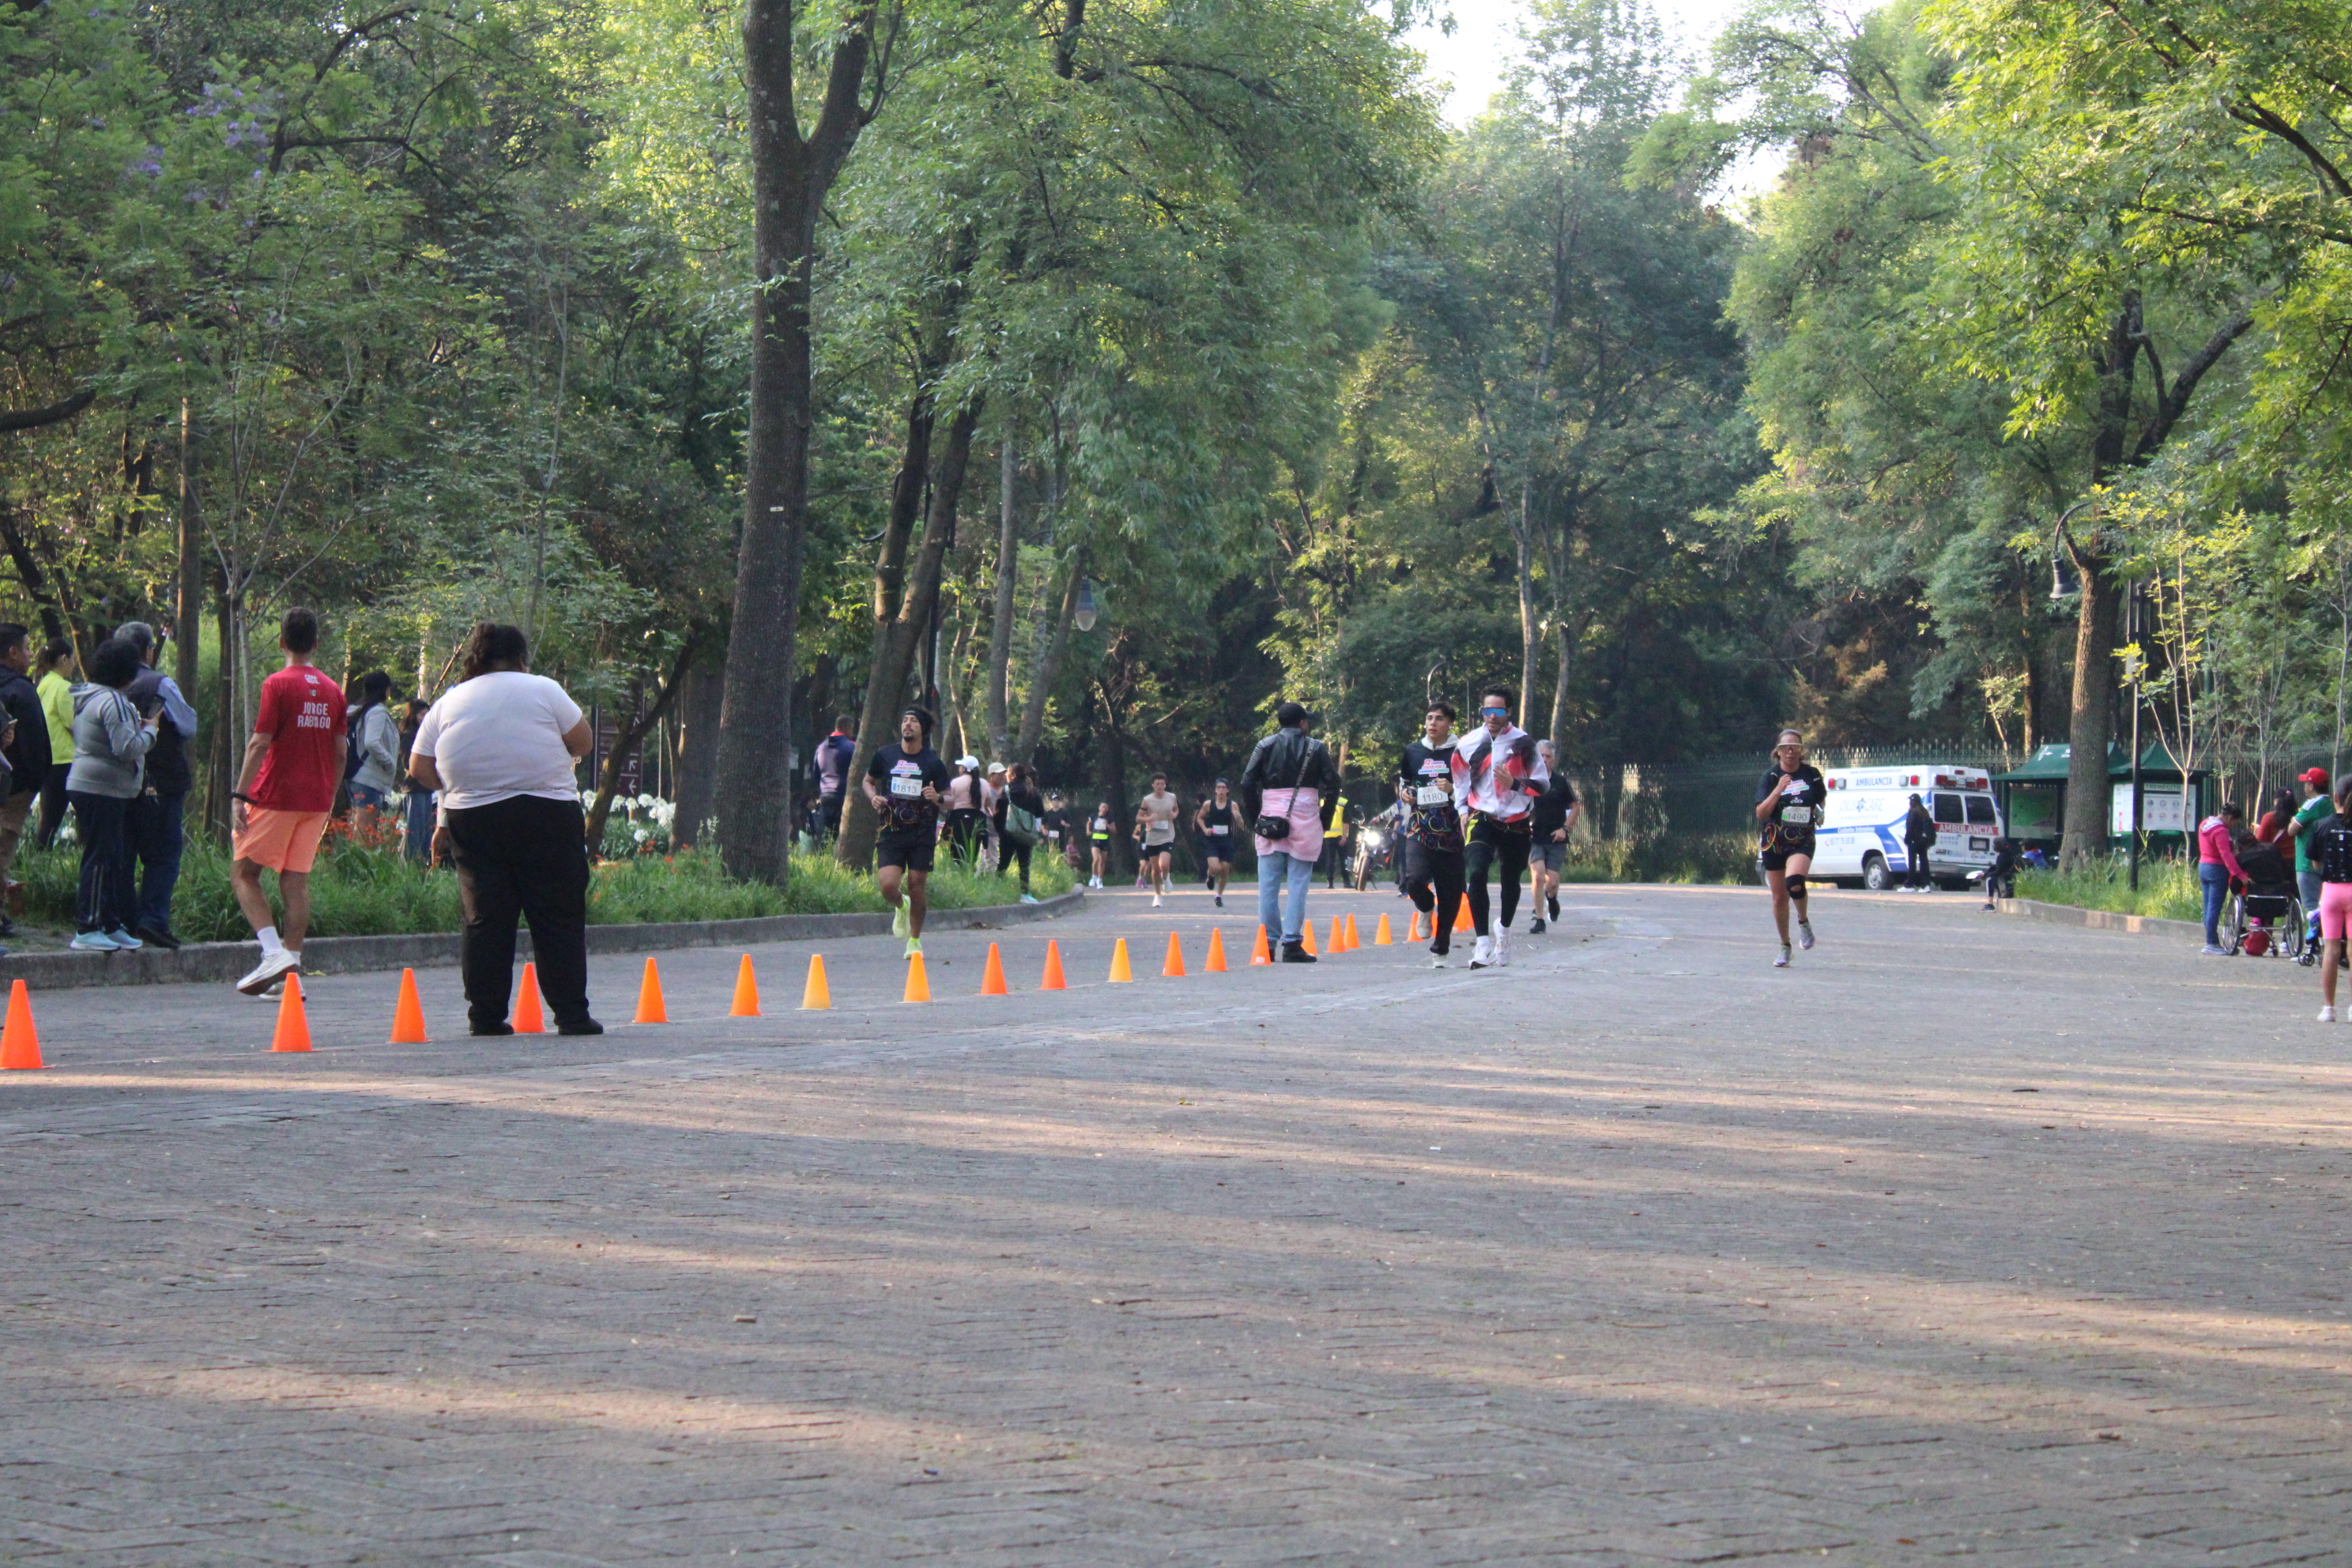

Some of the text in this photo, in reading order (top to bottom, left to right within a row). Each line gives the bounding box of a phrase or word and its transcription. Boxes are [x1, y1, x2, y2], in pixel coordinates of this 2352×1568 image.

[302, 702, 329, 716] JORGE
[1856, 777, 1893, 786] AMBULANCIA
[896, 784, 917, 794] 1813
[1423, 793, 1443, 802] 1180
[1865, 798, 1886, 811] CARE
[1788, 812, 1807, 821] 1490
[1939, 824, 1994, 835] AMBULANCIA
